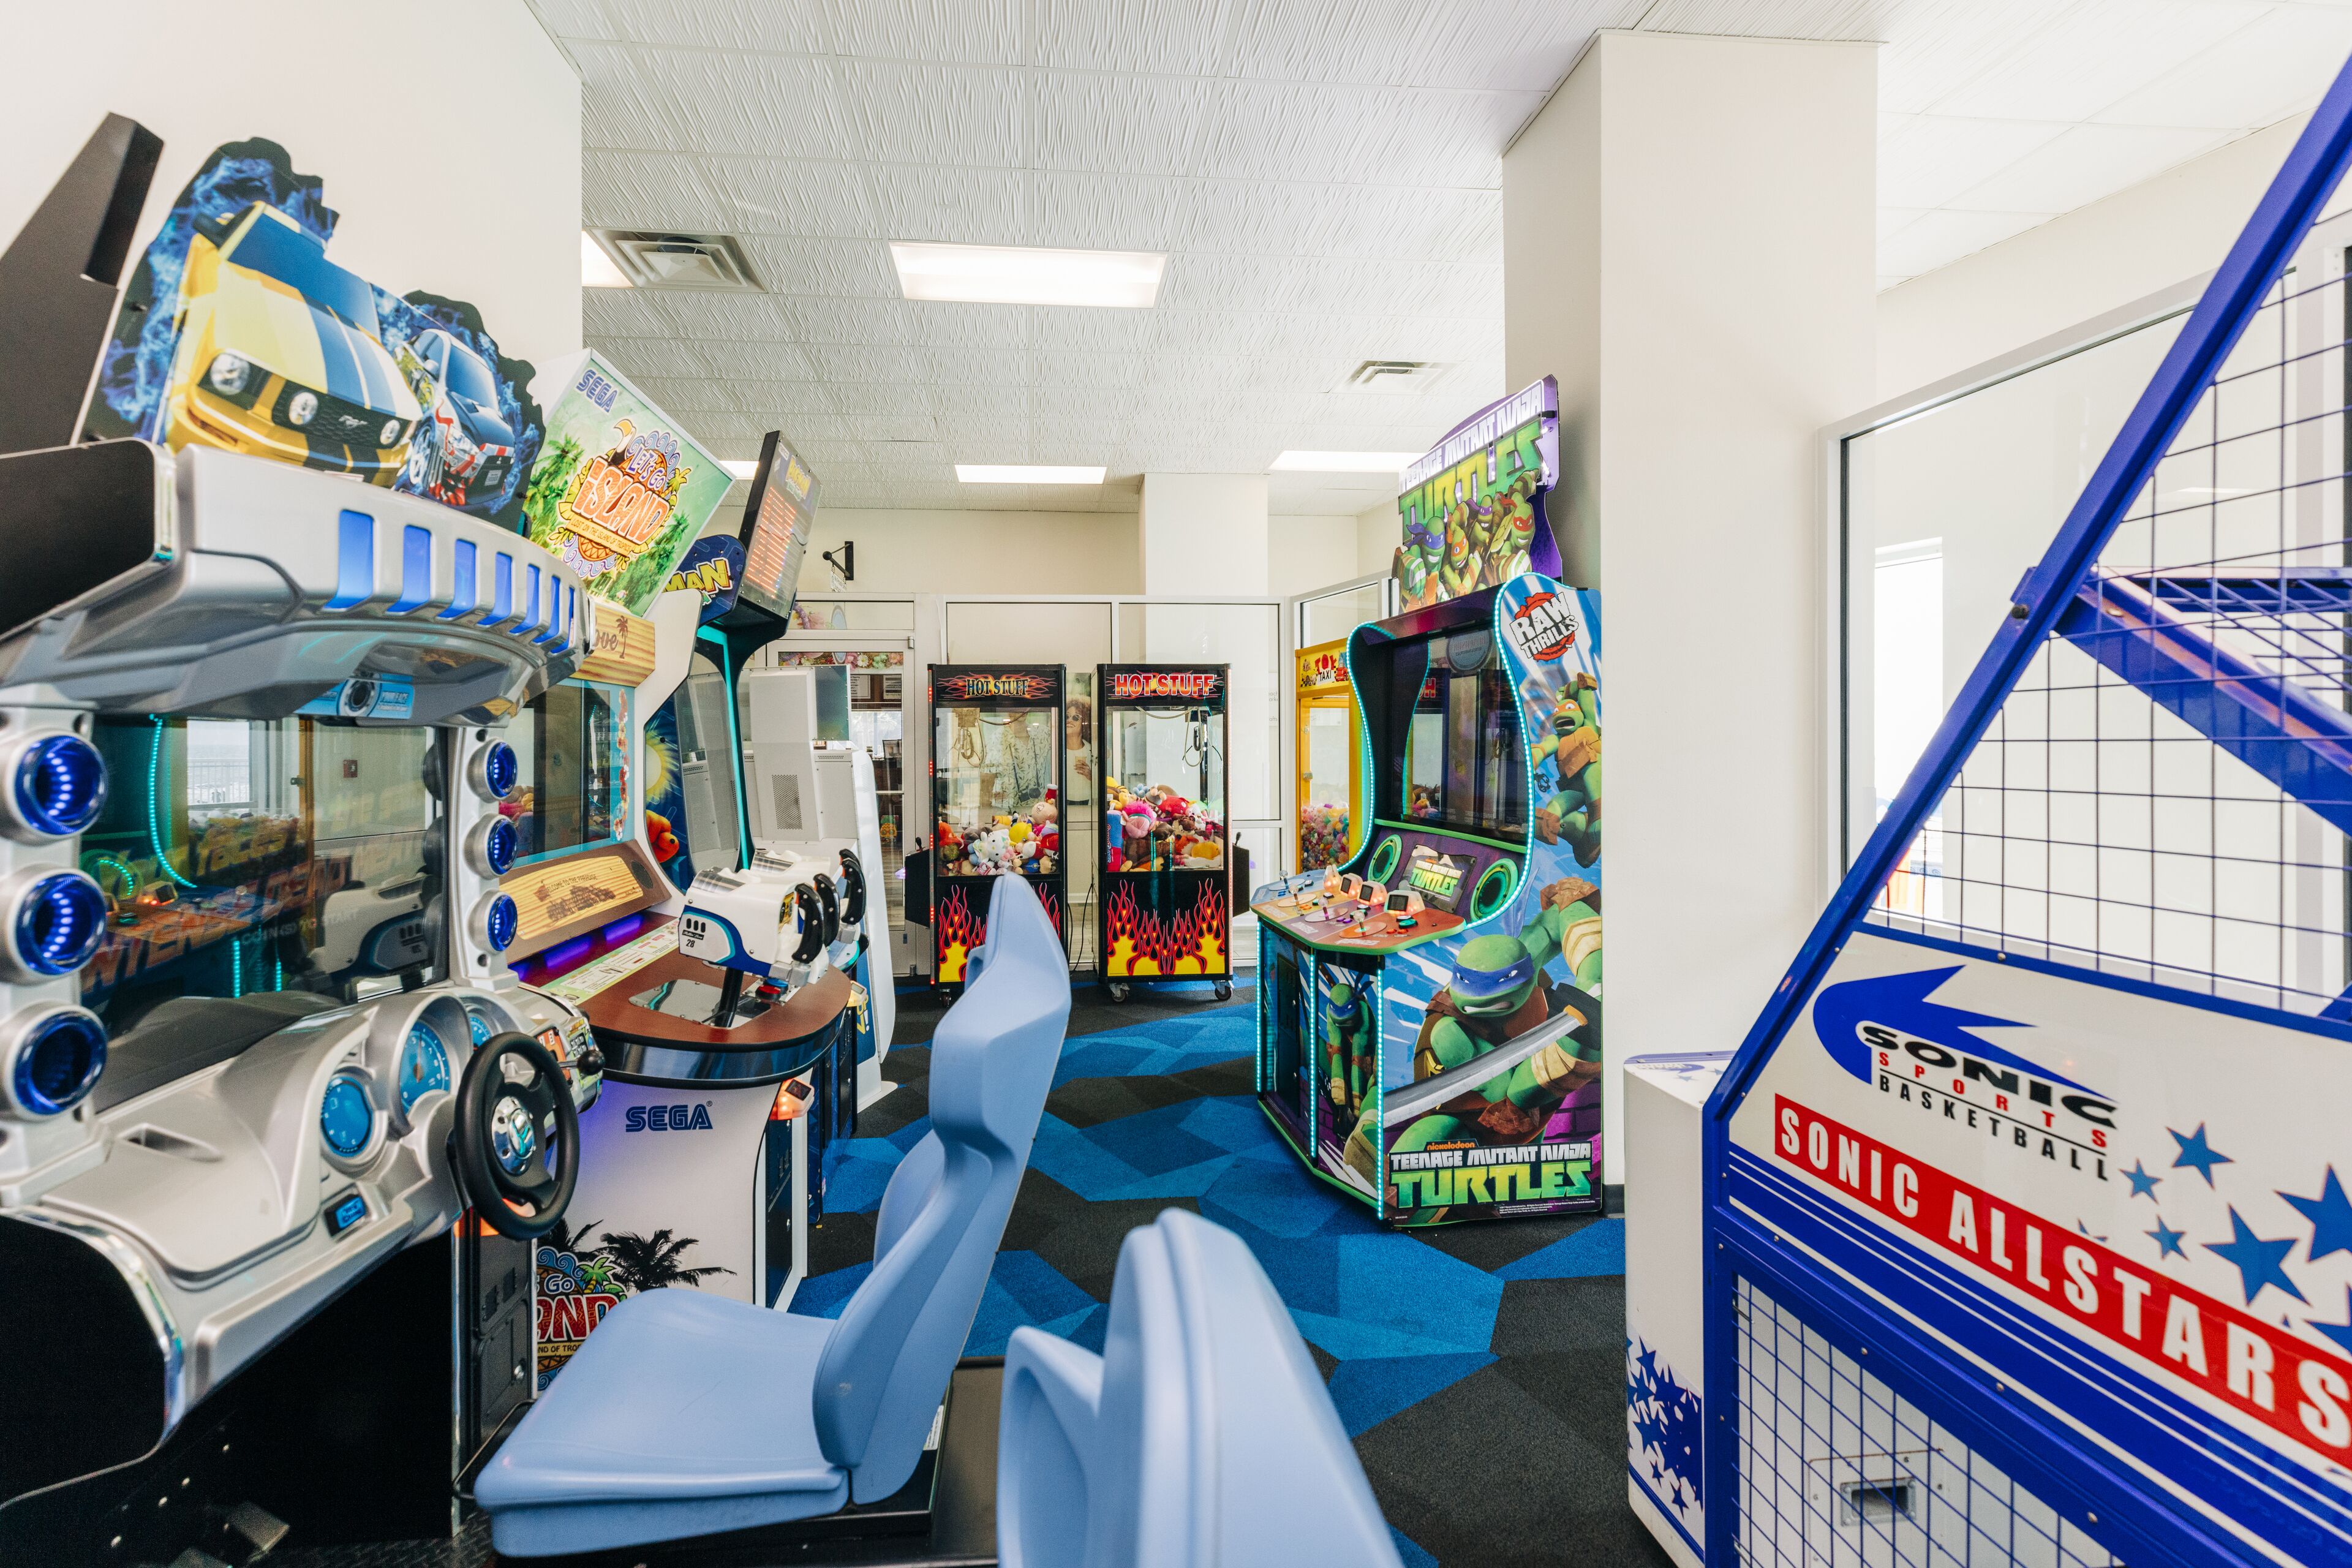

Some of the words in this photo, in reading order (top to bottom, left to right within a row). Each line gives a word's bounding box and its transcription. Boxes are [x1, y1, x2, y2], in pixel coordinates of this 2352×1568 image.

[576, 369, 617, 413] SEGA
[1444, 413, 1495, 469] MUTANT
[1496, 384, 1542, 437] NINJA
[1399, 417, 1542, 542] TURTLES
[1509, 592, 1570, 646] RAW
[1520, 615, 1579, 659] THRILLS
[1115, 674, 1153, 696] HOT
[1156, 674, 1215, 696] STUFF
[1314, 654, 1337, 675] TOY
[1319, 669, 1332, 682] TAXI
[966, 678, 991, 696] HOT
[993, 678, 1030, 696] STUFF
[1409, 867, 1459, 897] TURTLES
[686, 939, 695, 948] 28
[1863, 1026, 2118, 1130] SONIC
[1879, 1051, 2107, 1148] SPORTS
[1427, 1140, 1476, 1151] nickelodeon
[1879, 1074, 2108, 1182] BASKETBALL
[1390, 1151, 1463, 1170] TEENAGE
[1467, 1145, 1538, 1166] MUTANT
[1540, 1142, 1591, 1161] NINJA
[1390, 1160, 1591, 1208] TURTLES
[1780, 1106, 1920, 1219] SONIC
[1948, 1188, 2352, 1450] ALLSTARS
[550, 1344, 560, 1353] OF
